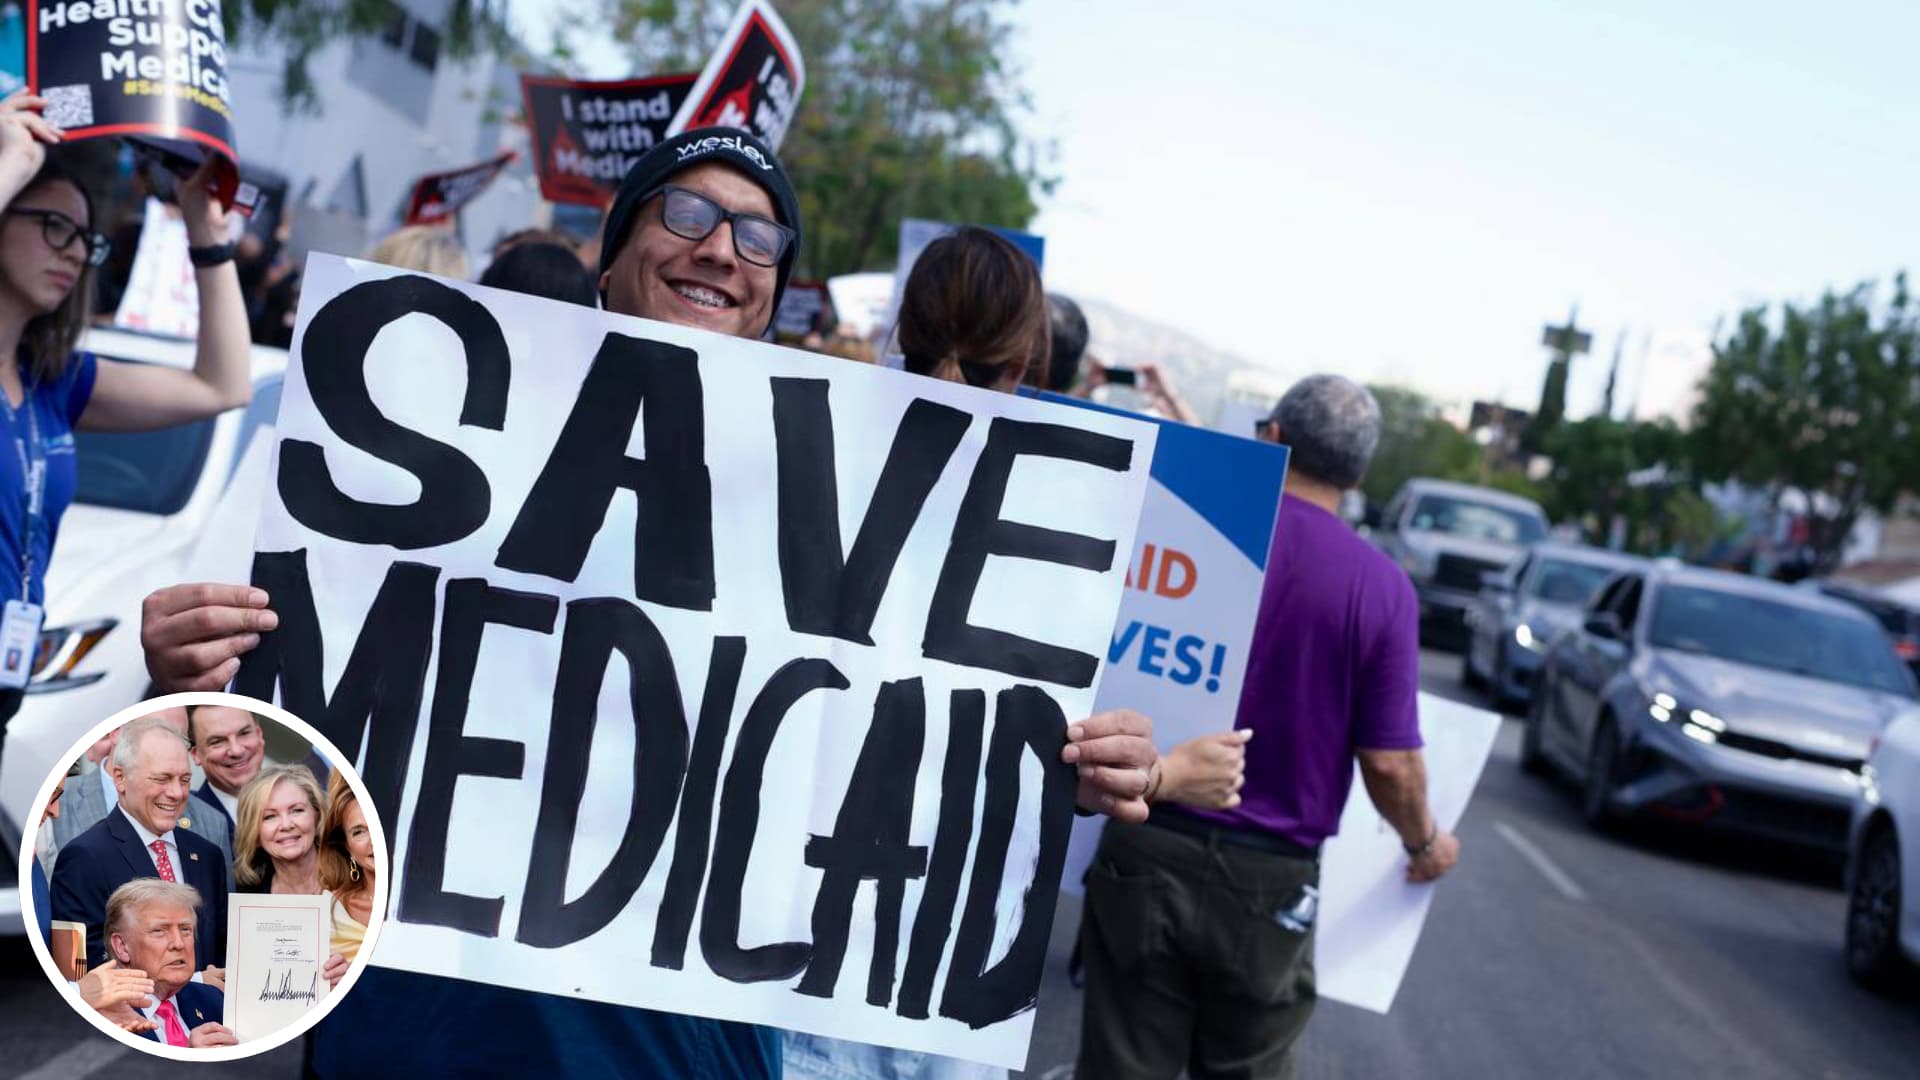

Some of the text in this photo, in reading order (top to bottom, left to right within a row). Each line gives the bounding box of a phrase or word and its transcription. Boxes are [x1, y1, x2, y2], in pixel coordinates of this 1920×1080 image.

[561, 91, 671, 124] I stand
[583, 123, 655, 151] with
[276, 274, 1134, 688] SAVE
[228, 547, 1078, 1031] MEDICAID
